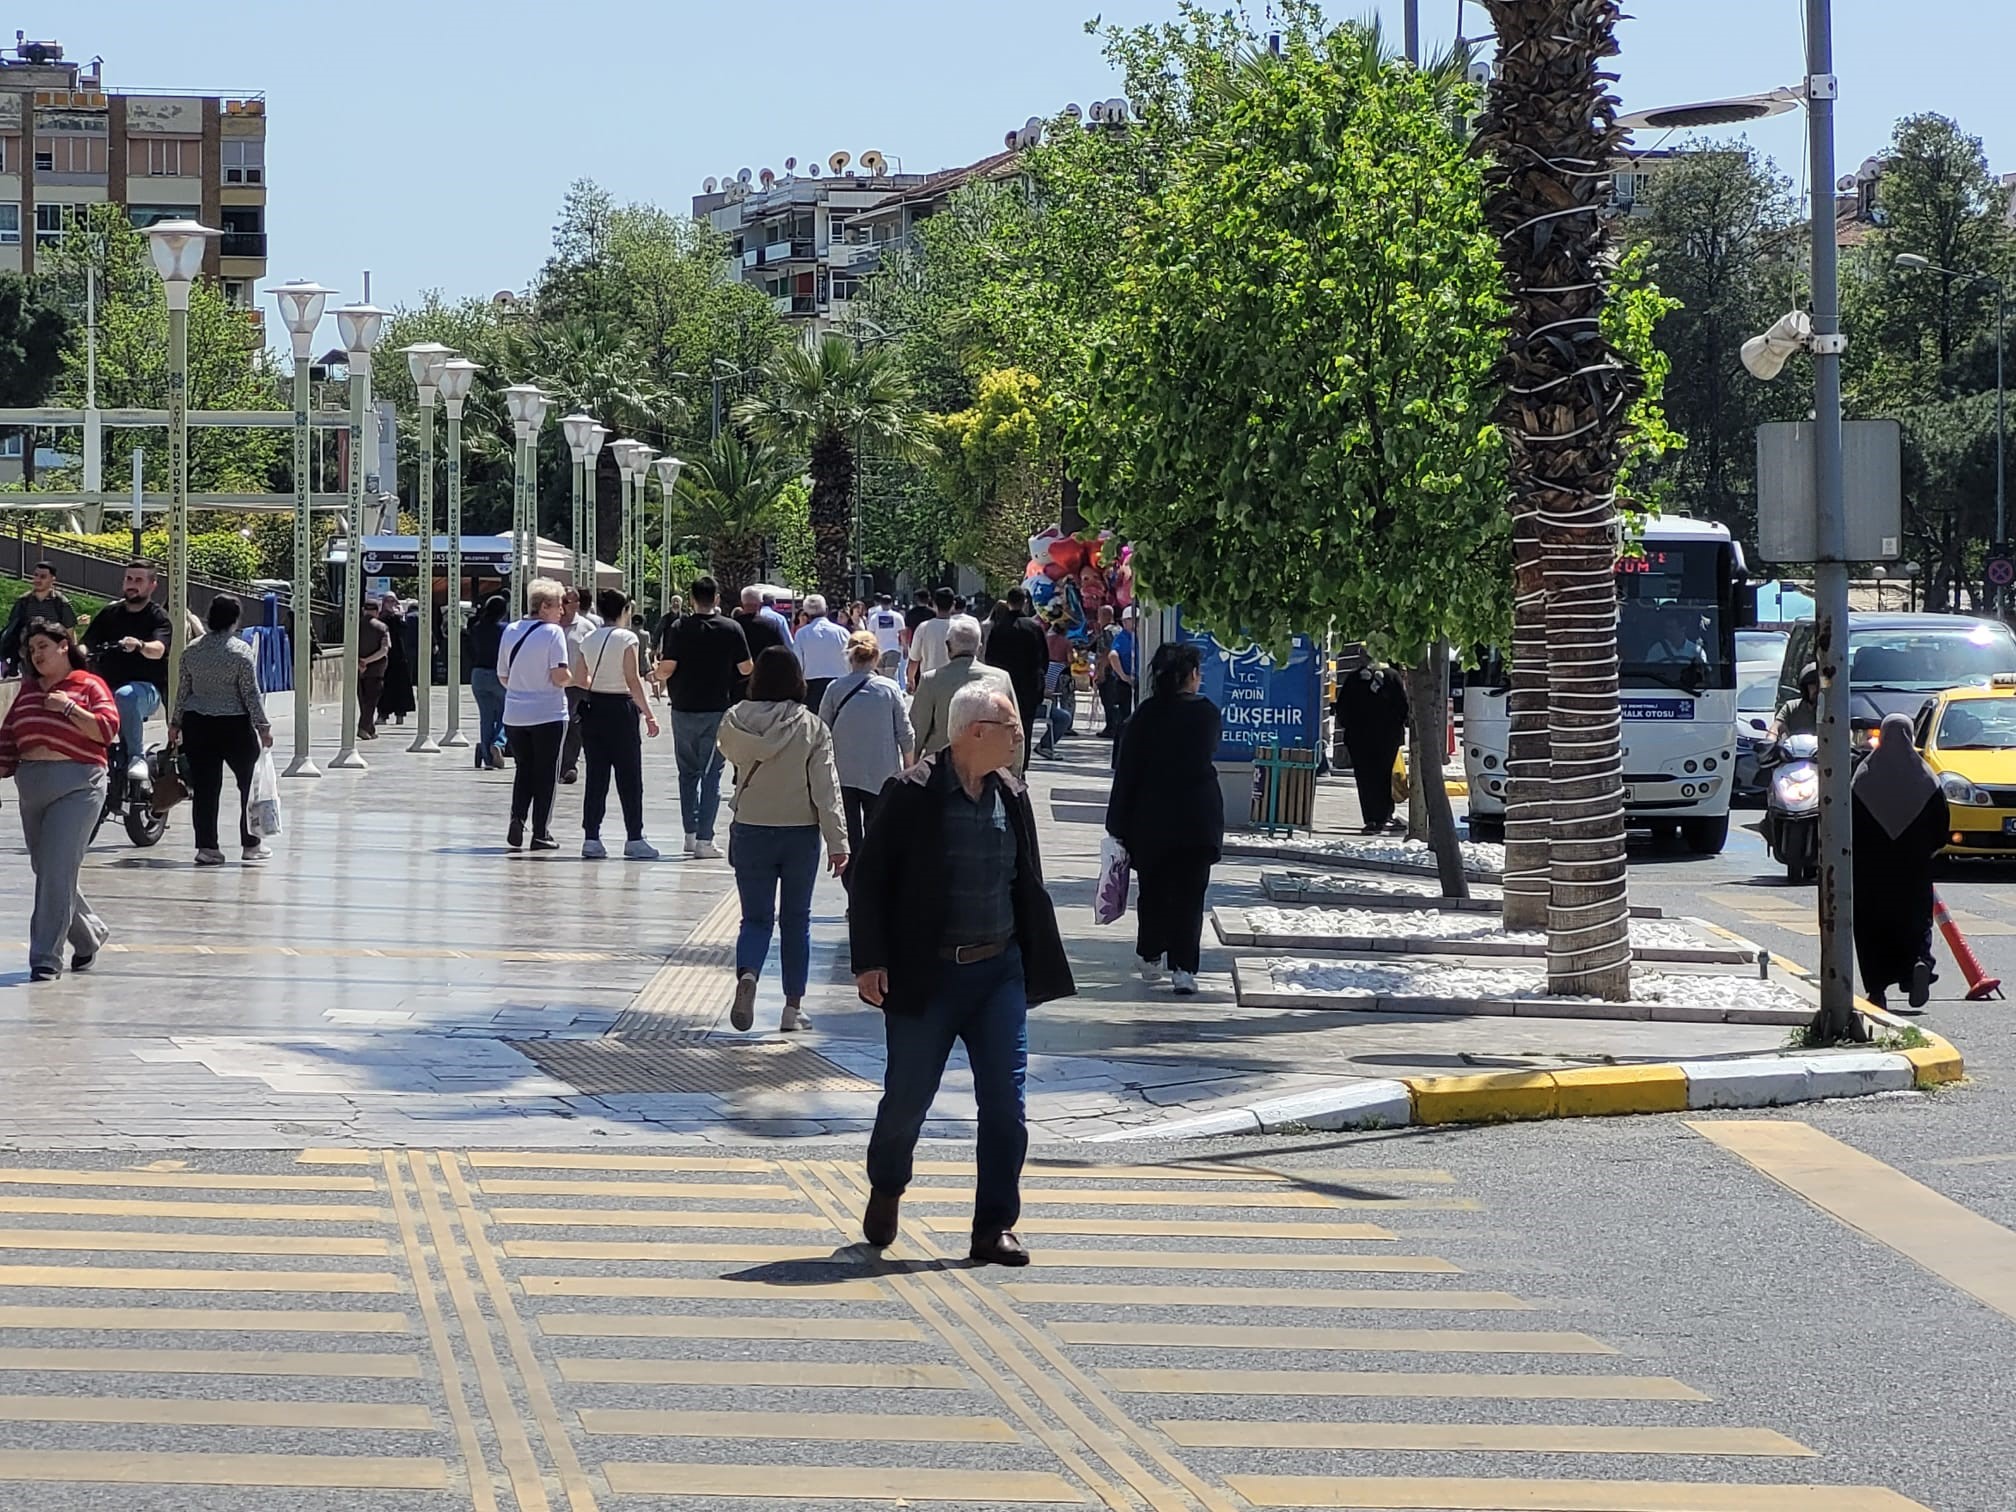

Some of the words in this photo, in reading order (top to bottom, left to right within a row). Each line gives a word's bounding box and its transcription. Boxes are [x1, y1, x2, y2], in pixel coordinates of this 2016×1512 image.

[1238, 673, 1258, 683] T.C.
[1231, 689, 1264, 701] AYDIN
[1221, 704, 1303, 728] ÜKŞEHİR
[1645, 710, 1675, 718] OTOSU
